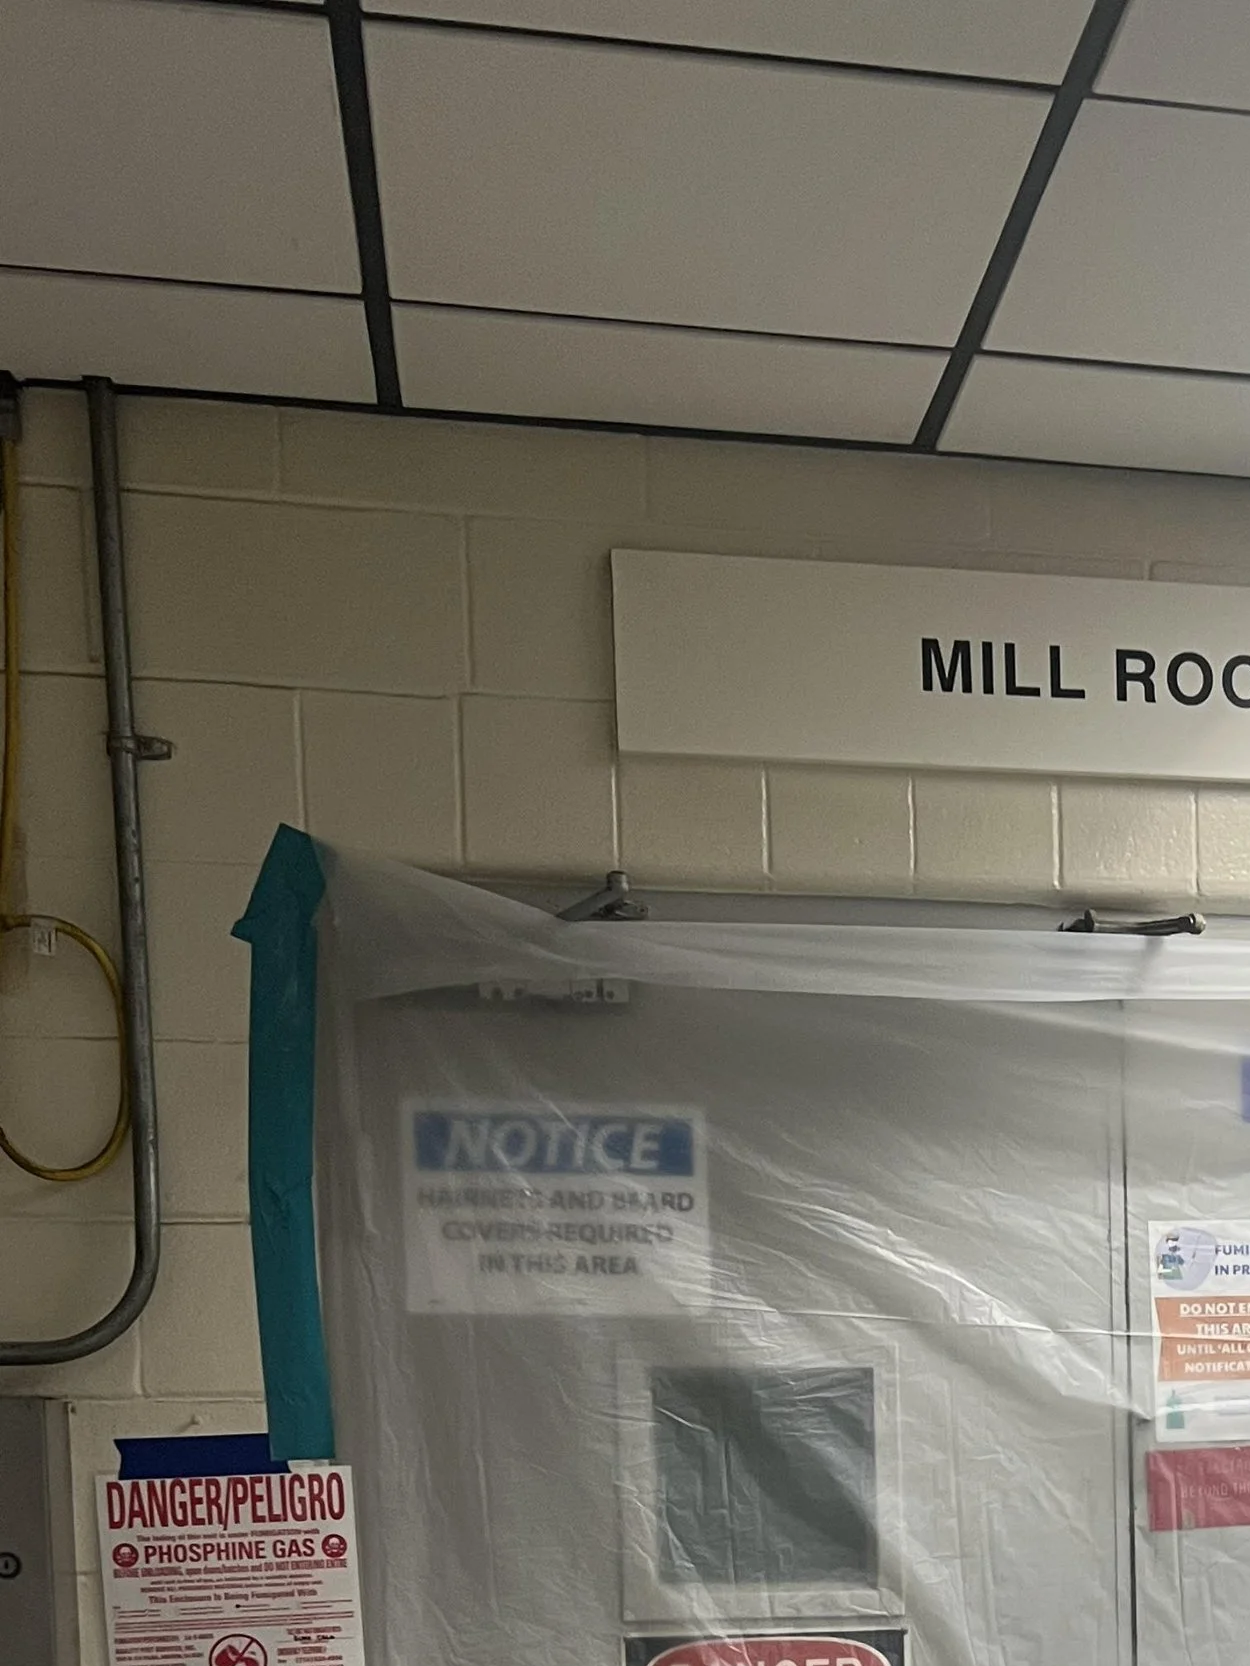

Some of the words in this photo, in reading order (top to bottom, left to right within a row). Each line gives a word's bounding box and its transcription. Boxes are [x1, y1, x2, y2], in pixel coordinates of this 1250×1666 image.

[920, 637, 1086, 699] MILL
[445, 1117, 664, 1170] NOTICE
[550, 1190, 605, 1212] AND
[478, 1254, 505, 1273] IN
[511, 1254, 567, 1274] THIS
[575, 1254, 639, 1275] AREA
[1214, 1264, 1230, 1276] IN
[1179, 1303, 1205, 1315] DO
[1206, 1302, 1237, 1315] NOT
[1195, 1323, 1229, 1335] THIS
[1177, 1343, 1216, 1355] UNTIL
[106, 1472, 346, 1531] DANGER/PELIGRO
[143, 1539, 267, 1565] PHOSPHINE
[272, 1537, 316, 1559] GAS
